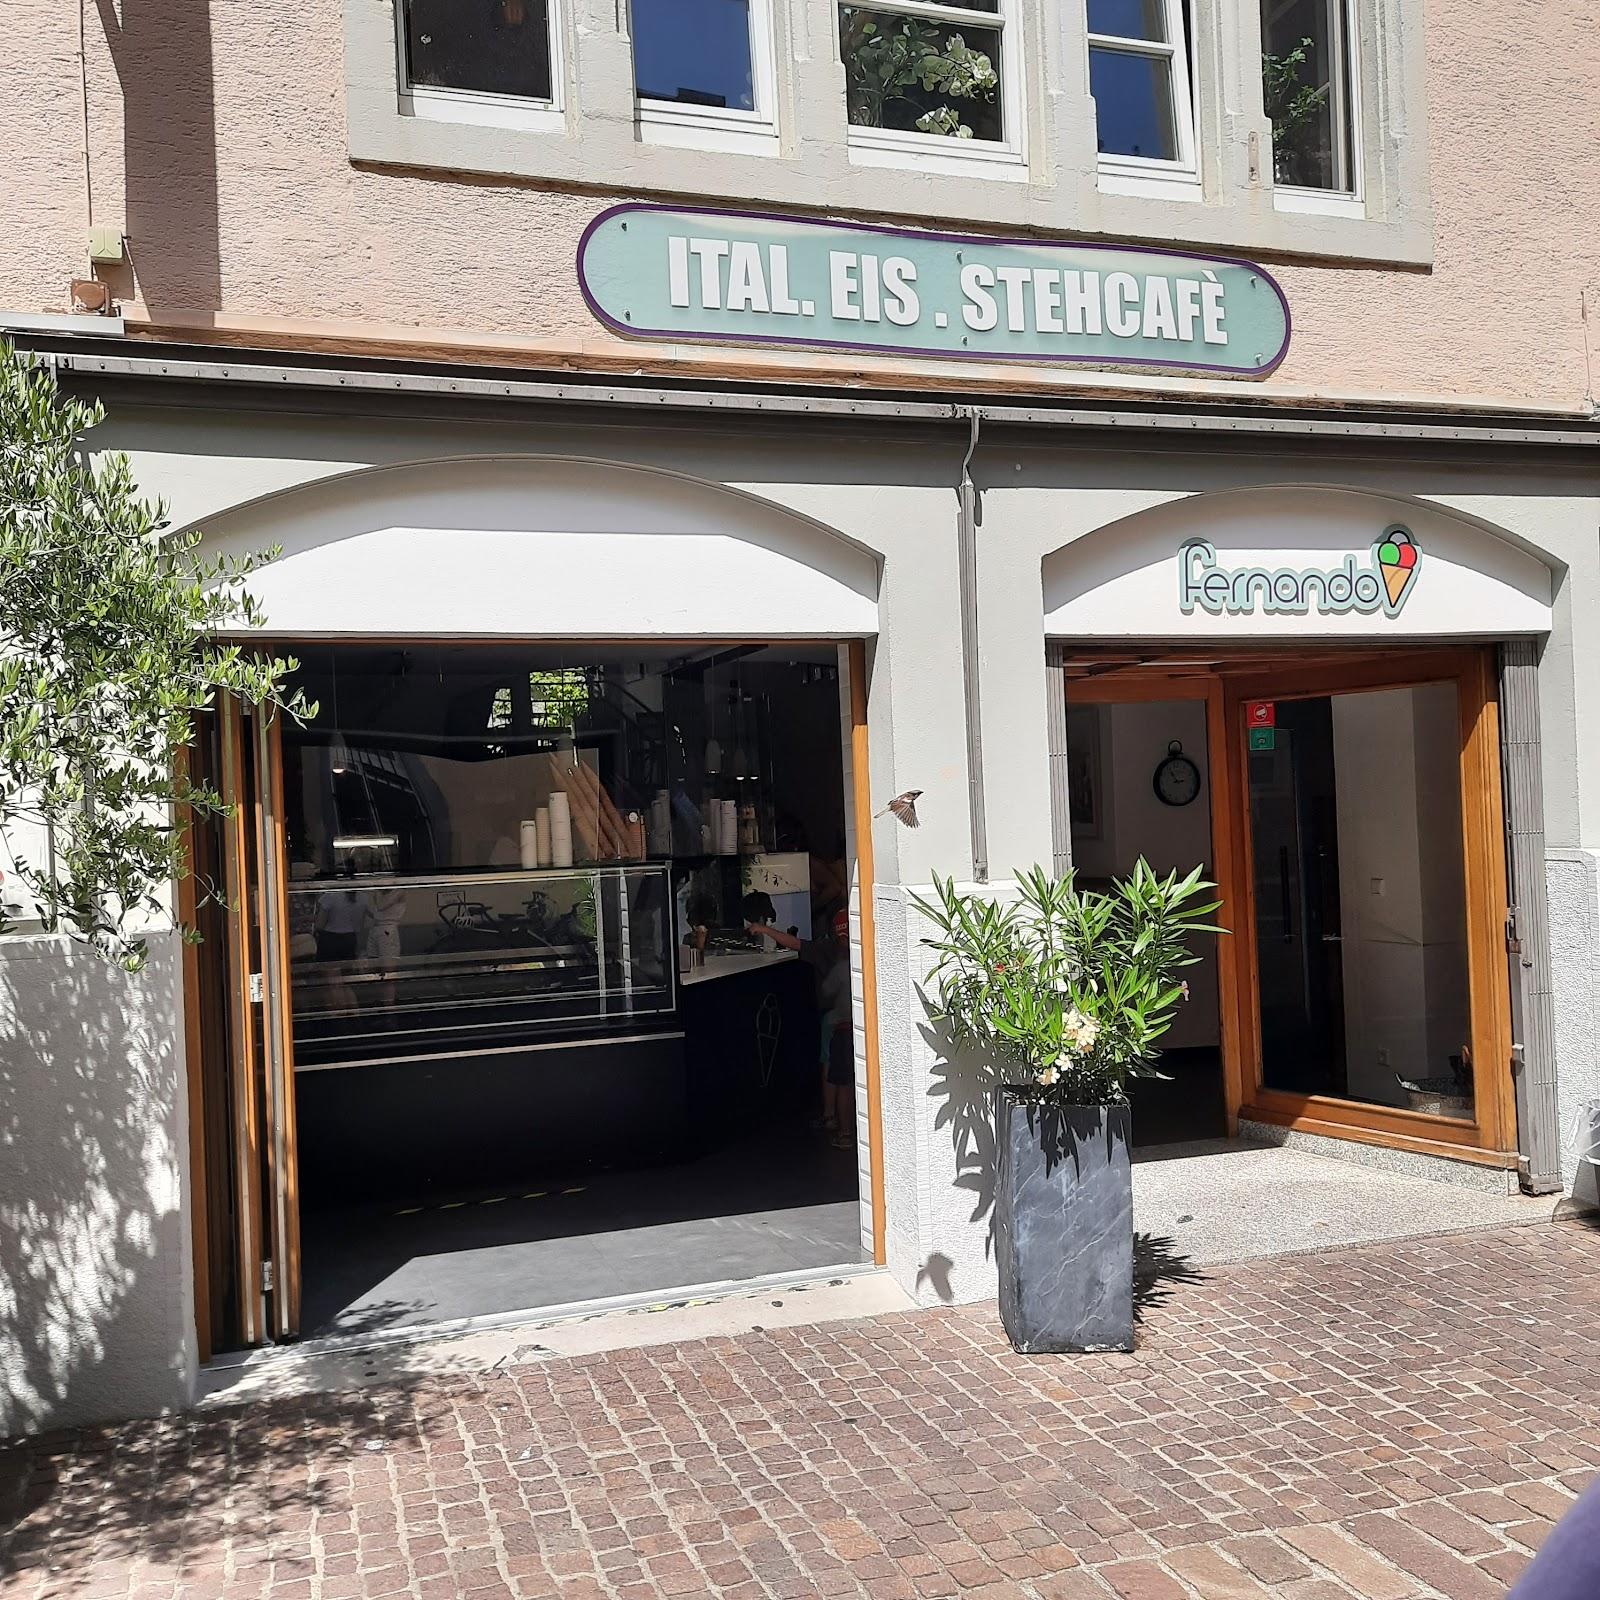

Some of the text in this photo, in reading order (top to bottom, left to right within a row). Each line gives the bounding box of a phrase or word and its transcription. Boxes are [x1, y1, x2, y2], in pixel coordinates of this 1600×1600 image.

[667, 235, 815, 317] ITAL.
[829, 250, 919, 327] EIS
[960, 262, 1229, 345] STEHCAFÈ
